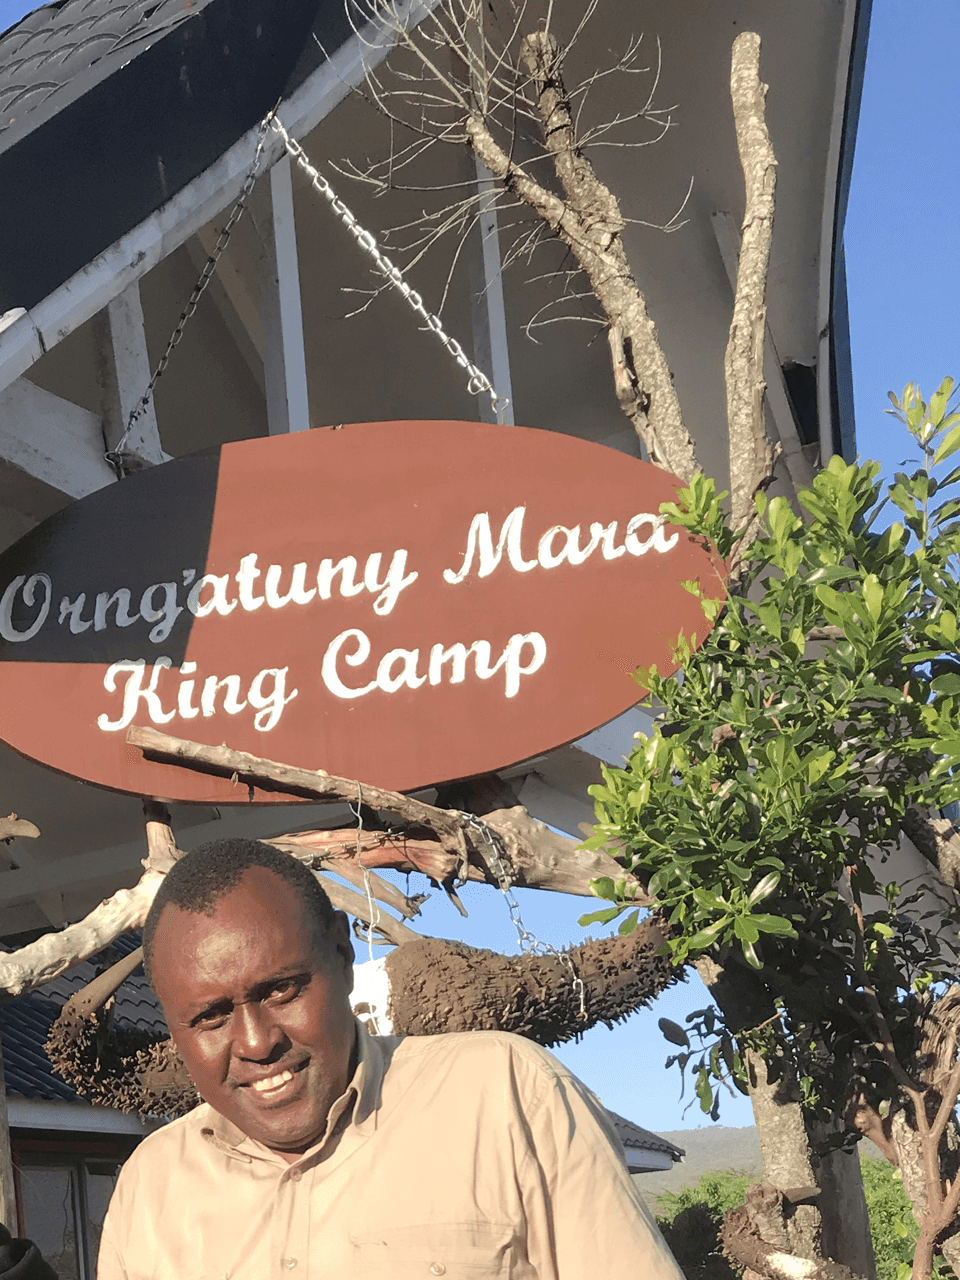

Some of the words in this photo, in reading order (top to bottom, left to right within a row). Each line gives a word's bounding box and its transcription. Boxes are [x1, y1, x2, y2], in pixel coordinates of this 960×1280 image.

[443, 505, 679, 584] Mara
[97, 655, 298, 732] King
[321, 627, 547, 698] Camp
